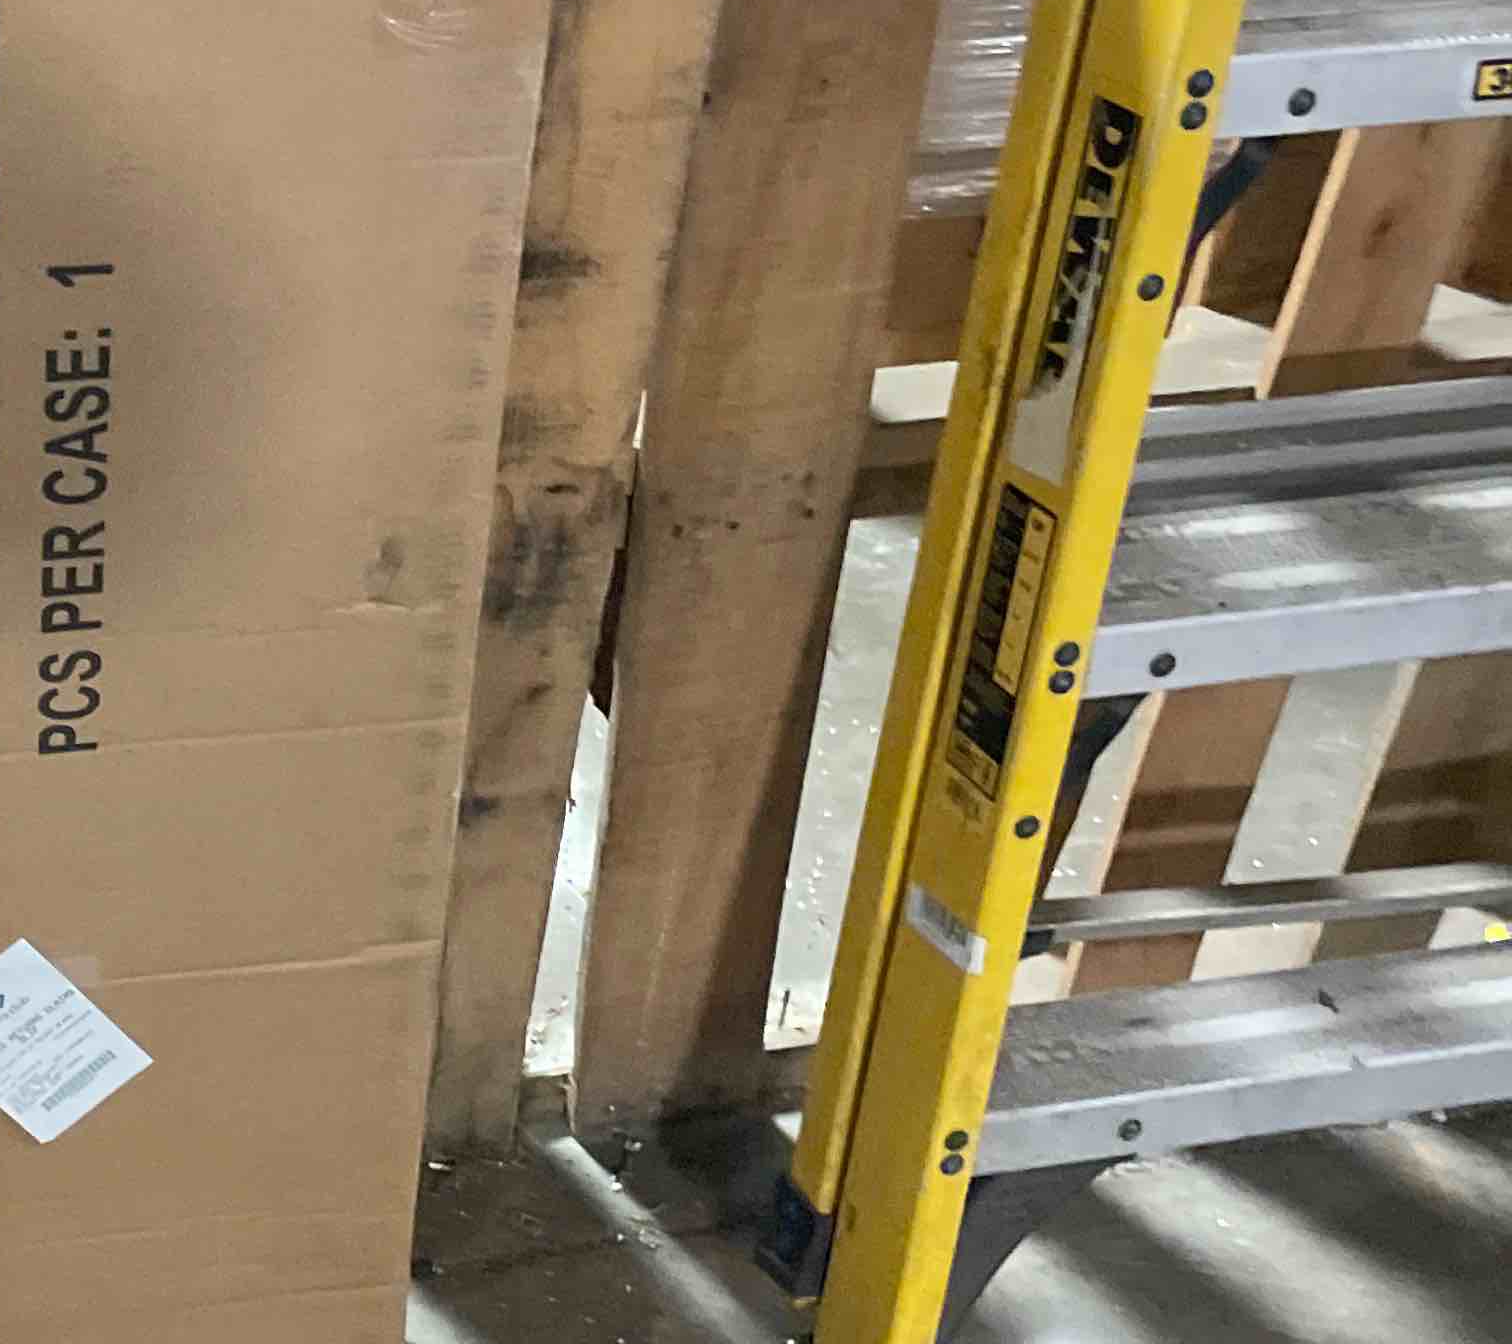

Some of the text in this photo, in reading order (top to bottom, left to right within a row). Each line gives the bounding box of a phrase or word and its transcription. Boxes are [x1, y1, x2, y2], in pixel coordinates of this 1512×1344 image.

[38, 262, 116, 757] PCS PER CASE: 1
